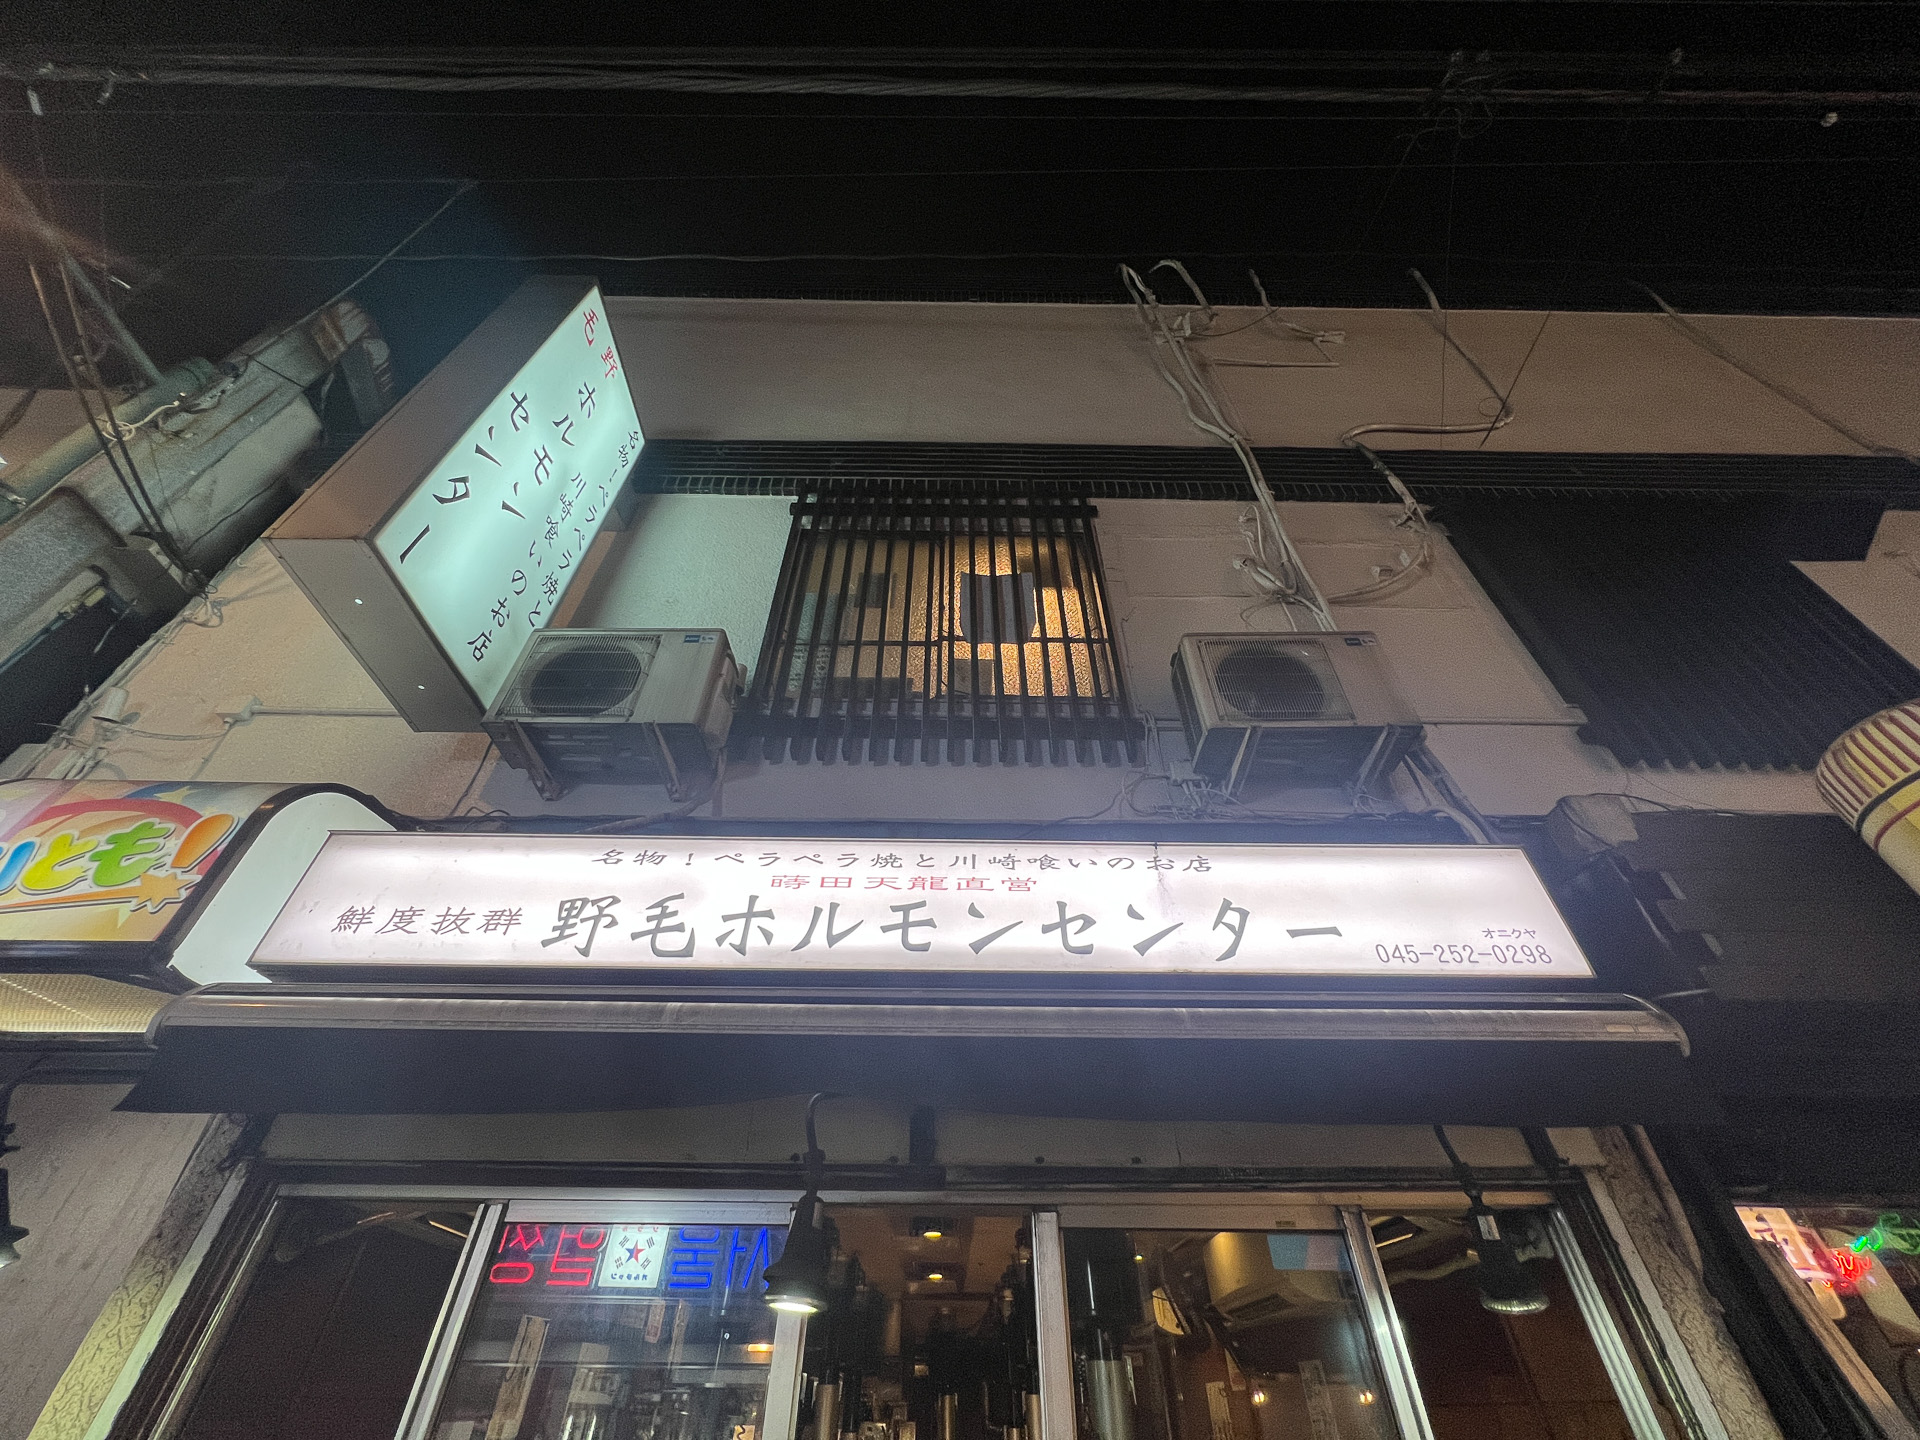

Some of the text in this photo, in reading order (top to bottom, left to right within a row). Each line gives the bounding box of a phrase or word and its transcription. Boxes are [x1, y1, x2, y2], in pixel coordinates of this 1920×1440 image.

[501, 381, 597, 520] ホルモン
[399, 391, 530, 564] センター
[770, 874, 1038, 893] 蒔田天龍直営
[330, 905, 522, 937] 鮮度抜群
[541, 892, 1343, 960] 野毛ホルモンセンター
[1482, 927, 1537, 939] オニクヤ
[1375, 942, 1553, 966] 045-252-0298
